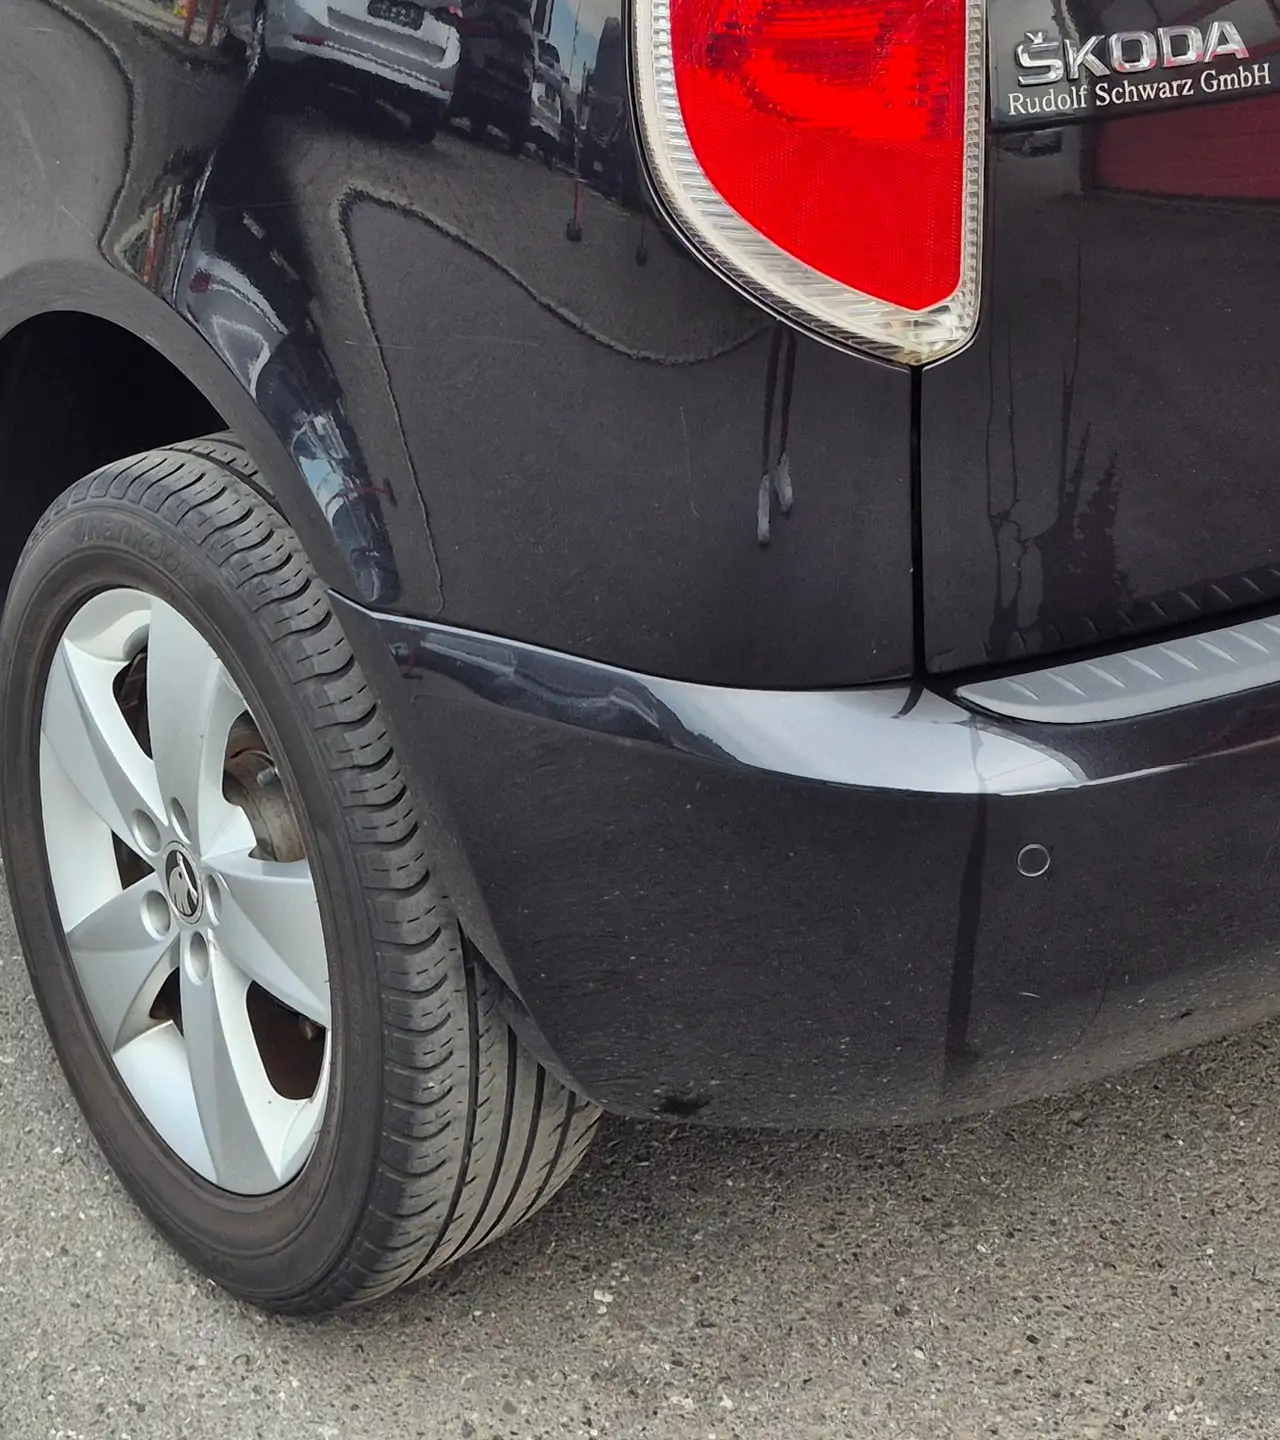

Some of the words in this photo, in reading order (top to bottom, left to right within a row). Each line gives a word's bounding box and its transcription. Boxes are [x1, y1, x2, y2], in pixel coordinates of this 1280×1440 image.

[1016, 21, 1250, 86] ŠKODA
[1008, 85, 1088, 115] Rudolf
[1095, 76, 1194, 107] Schwarz
[1200, 63, 1272, 94] GmbH
